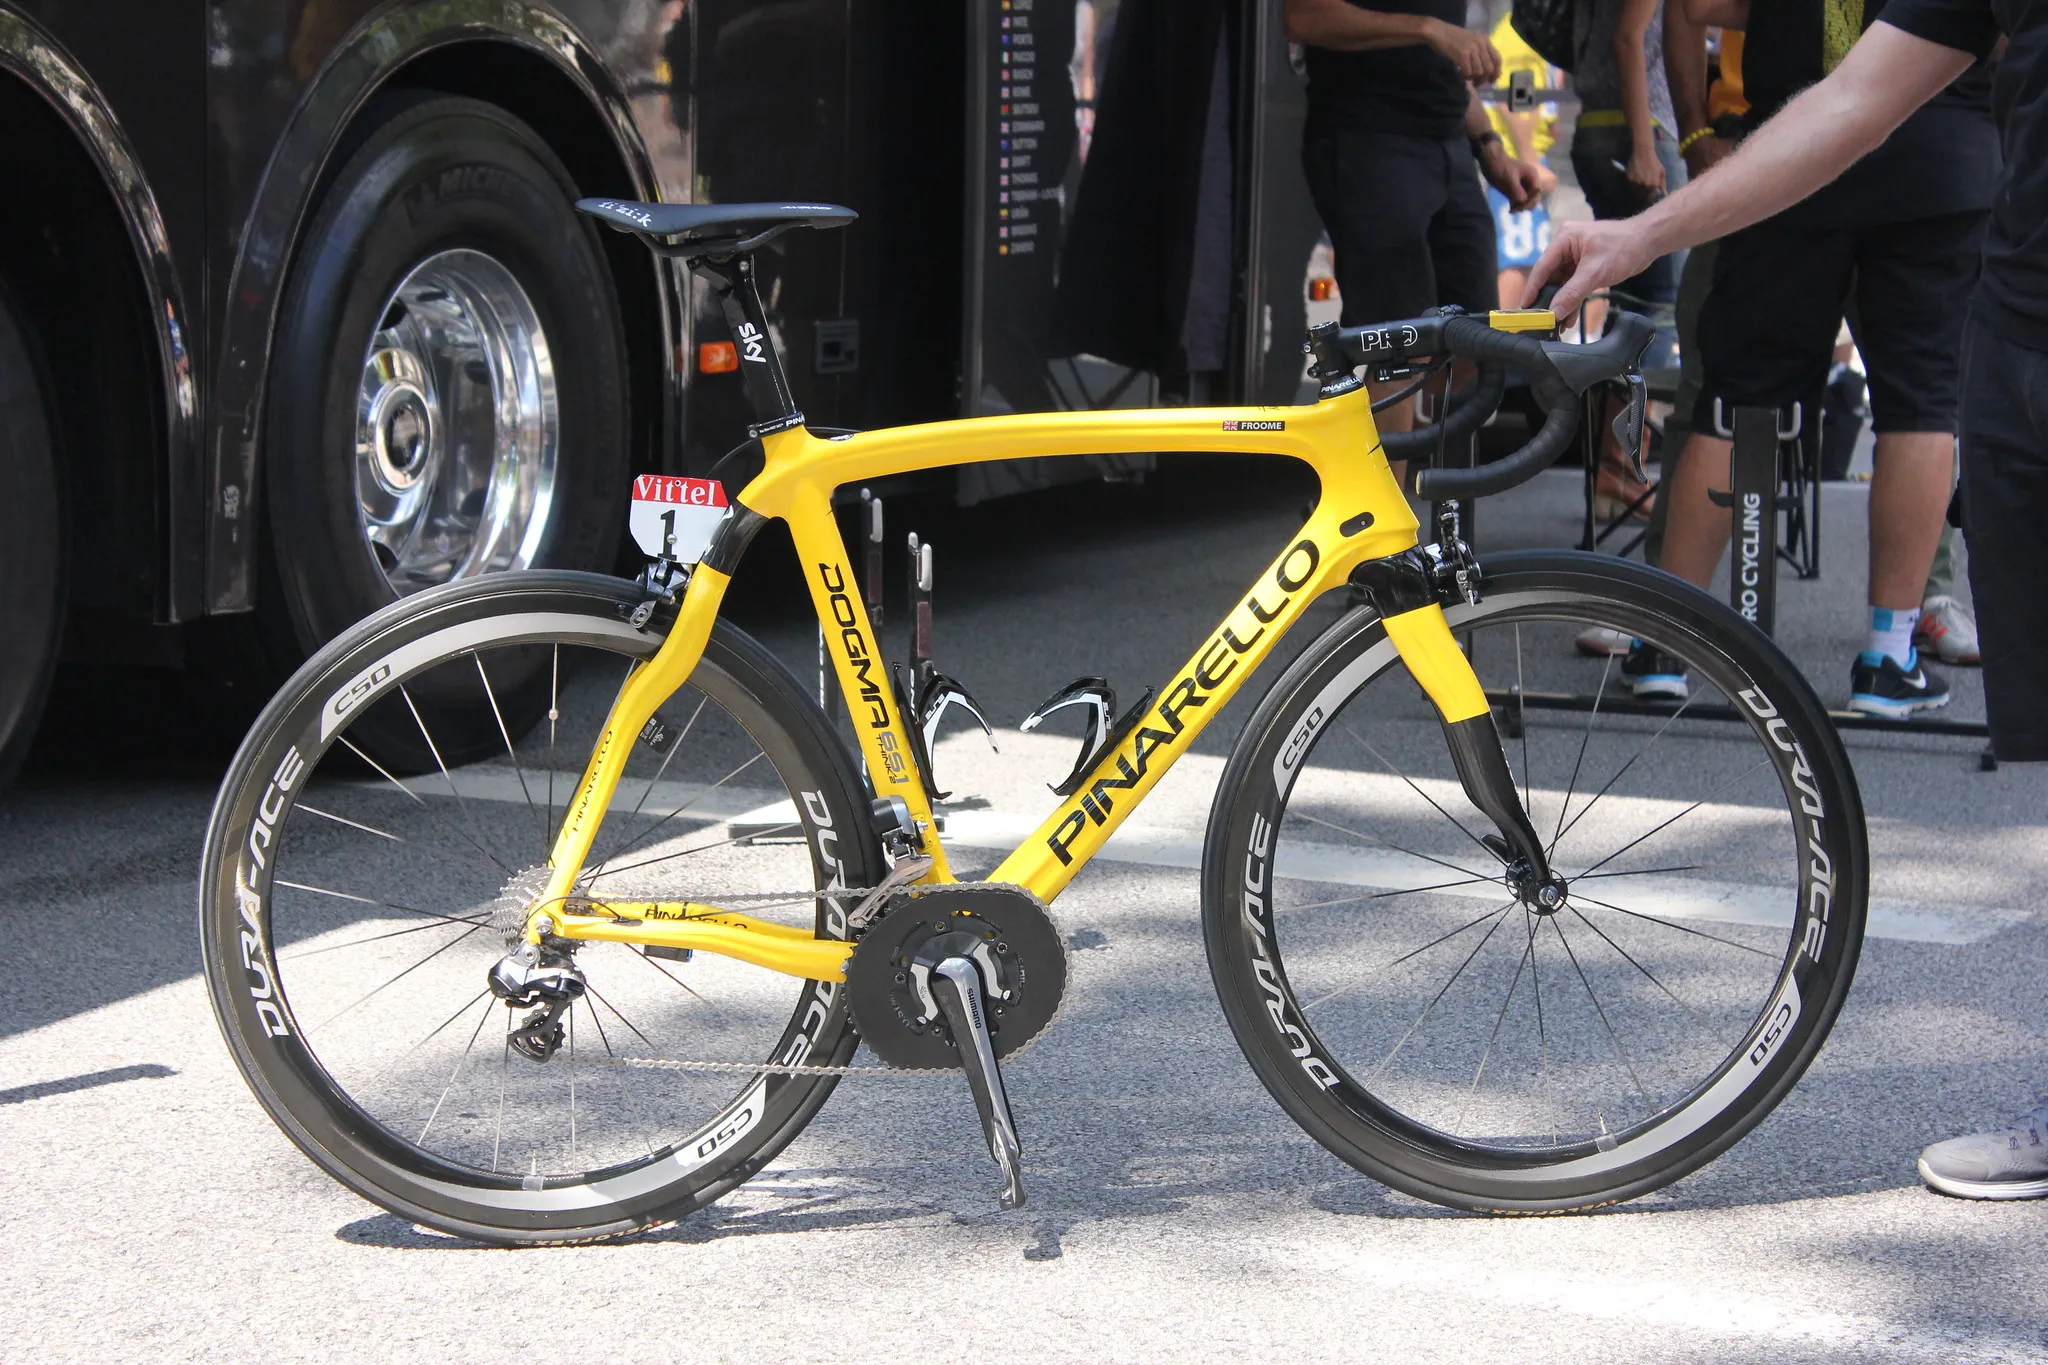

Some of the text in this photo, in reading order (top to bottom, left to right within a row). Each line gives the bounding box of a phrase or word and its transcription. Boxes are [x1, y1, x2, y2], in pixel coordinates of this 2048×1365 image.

[738, 322, 767, 363] sky
[1241, 422, 1282, 430] FROOME
[637, 476, 715, 505] Vittel
[657, 510, 677, 561] 1
[1741, 493, 1760, 621] RO CYCLING
[818, 563, 890, 729] DOGMA
[333, 664, 391, 717] C50
[1047, 539, 1320, 867] PINARELLO
[1282, 706, 1324, 770] C50
[1738, 689, 1831, 963] DURA-ACE
[240, 745, 304, 1038] DURA-ACE
[1244, 812, 1340, 1092] DURA-ACE
[967, 988, 981, 1029] SHIMANO
[1750, 1003, 1792, 1067] C50
[697, 1108, 753, 1159] C50
[534, 1223, 654, 1246] VELOFLEX
